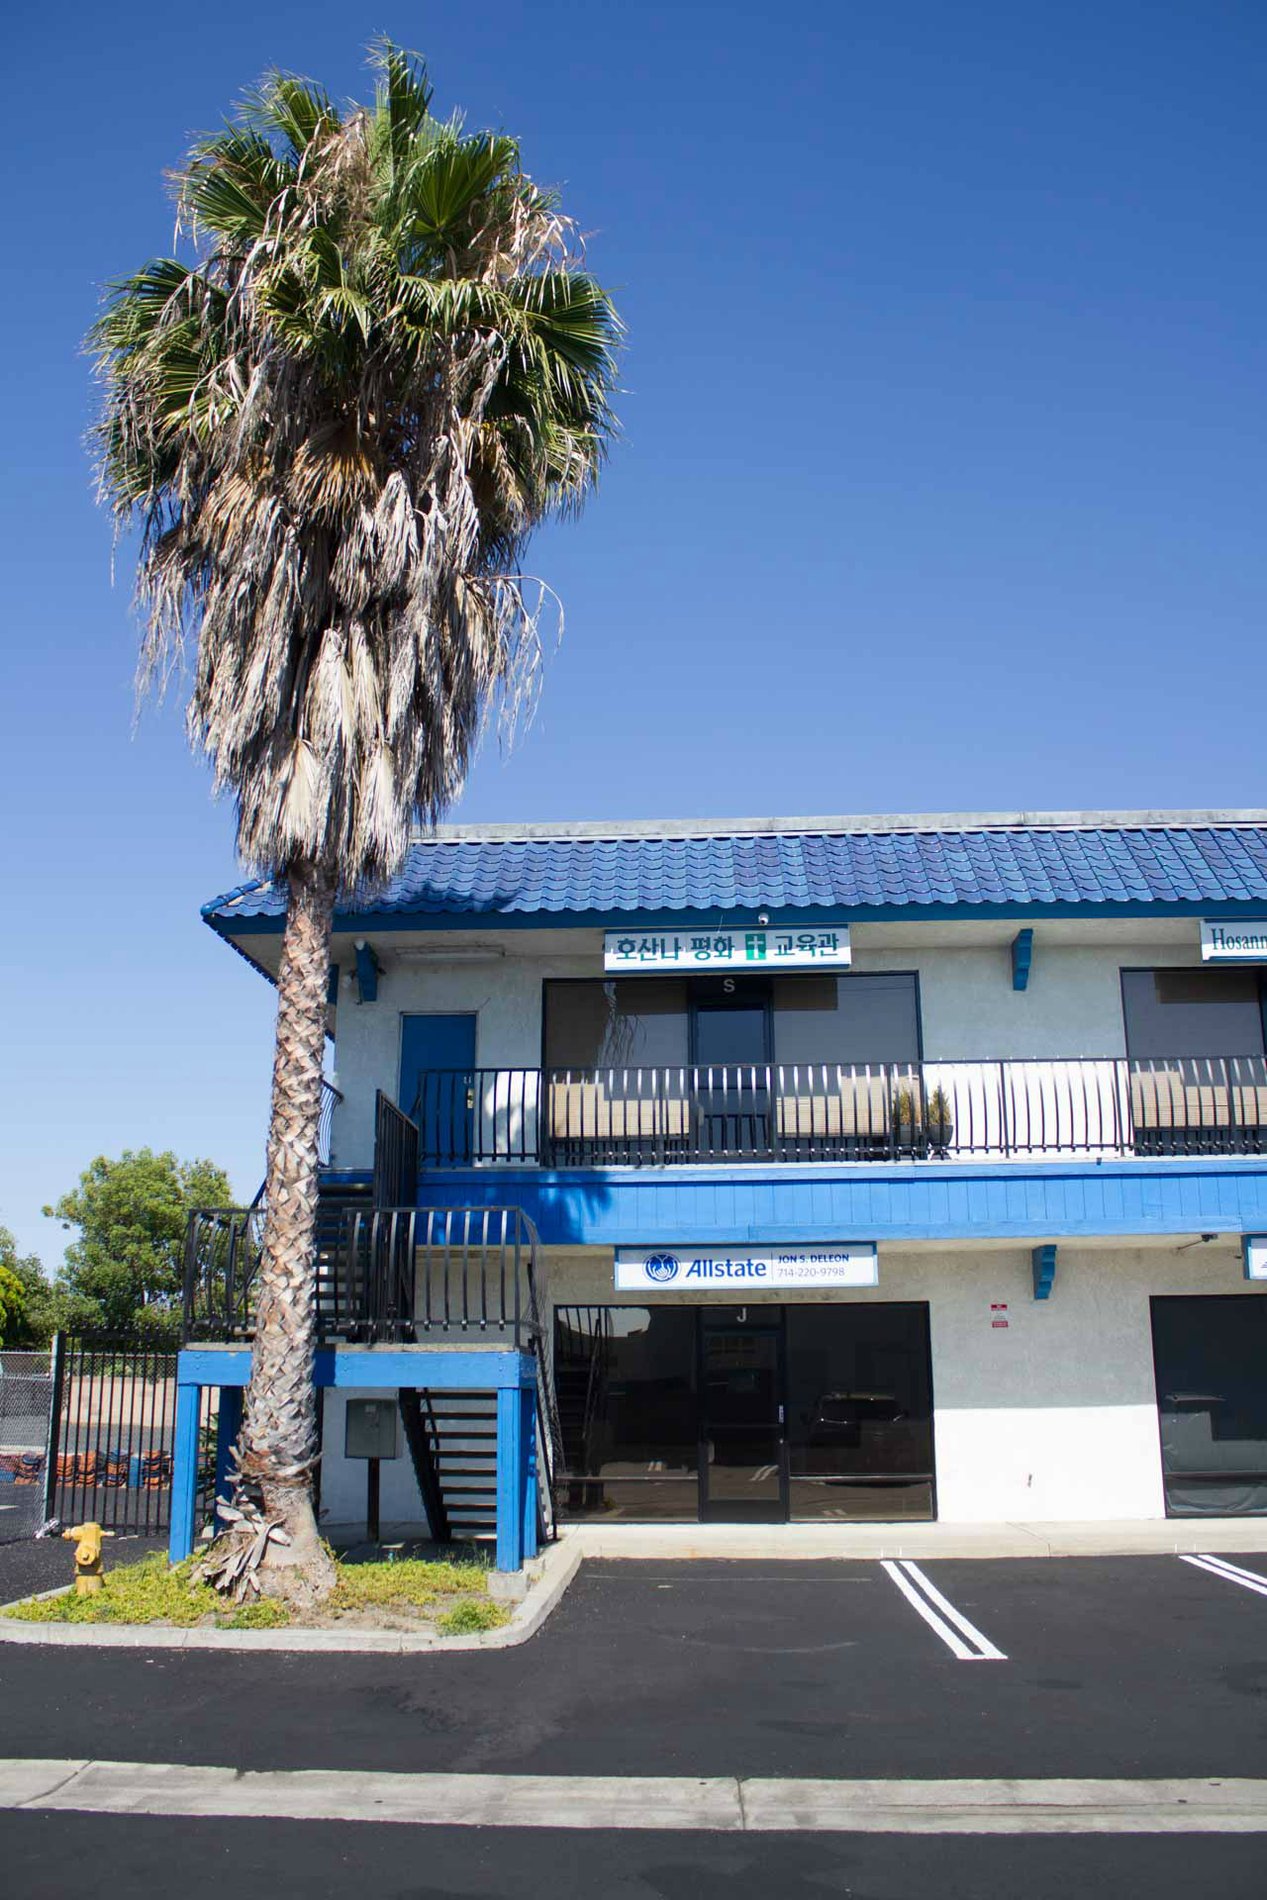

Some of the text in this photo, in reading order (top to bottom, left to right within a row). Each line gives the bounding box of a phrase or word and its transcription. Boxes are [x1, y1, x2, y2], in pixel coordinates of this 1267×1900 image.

[616, 933, 839, 961] 호산나 평화 교육관
[723, 979, 735, 993] S
[778, 1253, 849, 1264] JON S. DELEON
[685, 1259, 767, 1277] Allstate
[778, 1267, 845, 1277] 714-220-9798
[736, 1307, 747, 1322] J
